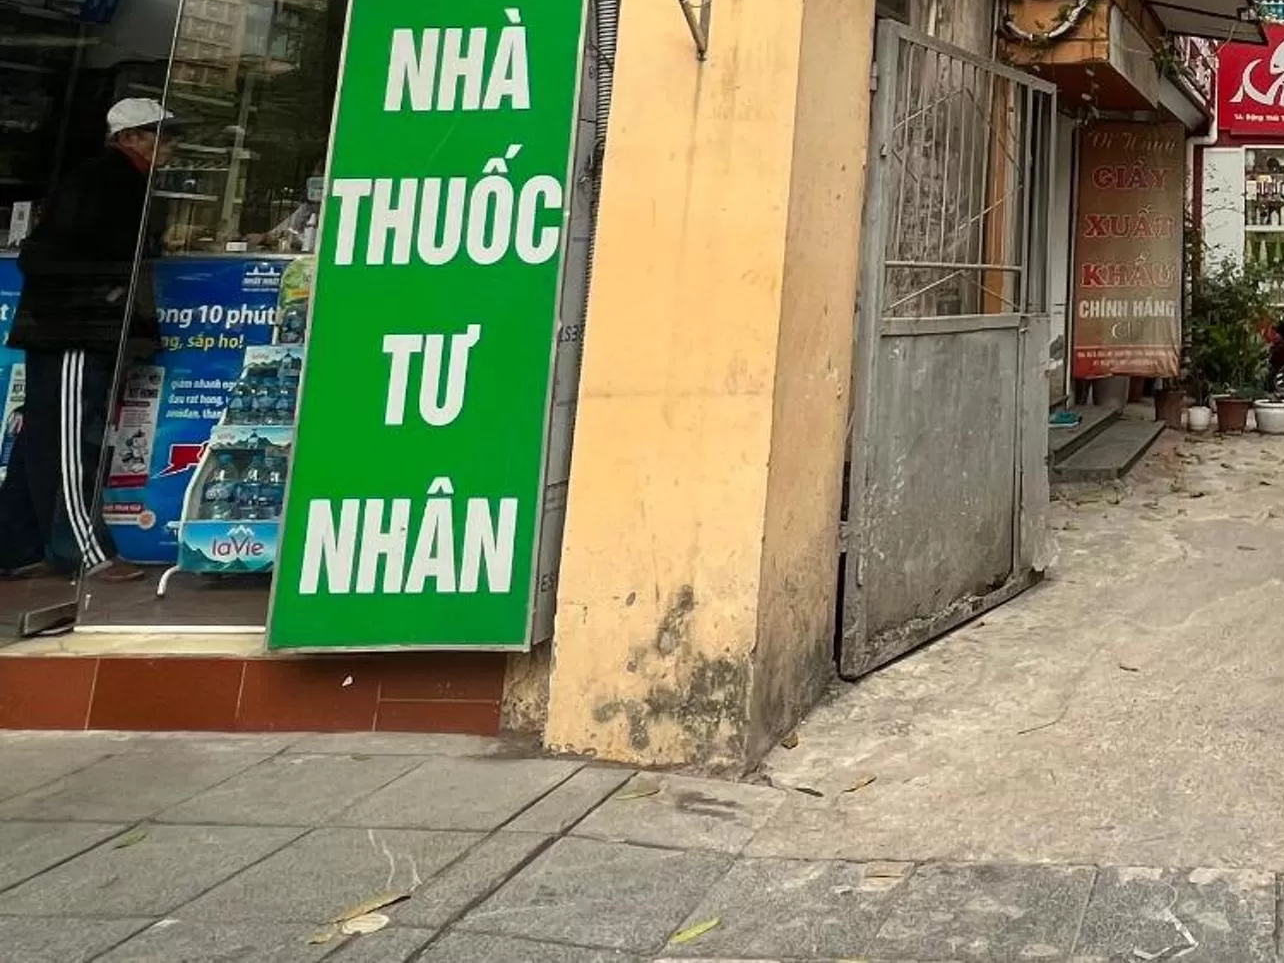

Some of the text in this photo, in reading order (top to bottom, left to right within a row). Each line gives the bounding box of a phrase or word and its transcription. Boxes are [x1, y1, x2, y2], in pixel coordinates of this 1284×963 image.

[383, 7, 531, 112] NHÀ
[332, 144, 564, 267] THUỐC
[198, 304, 223, 324] 10
[383, 324, 481, 426] TƯ
[298, 476, 519, 595] NHÂN
